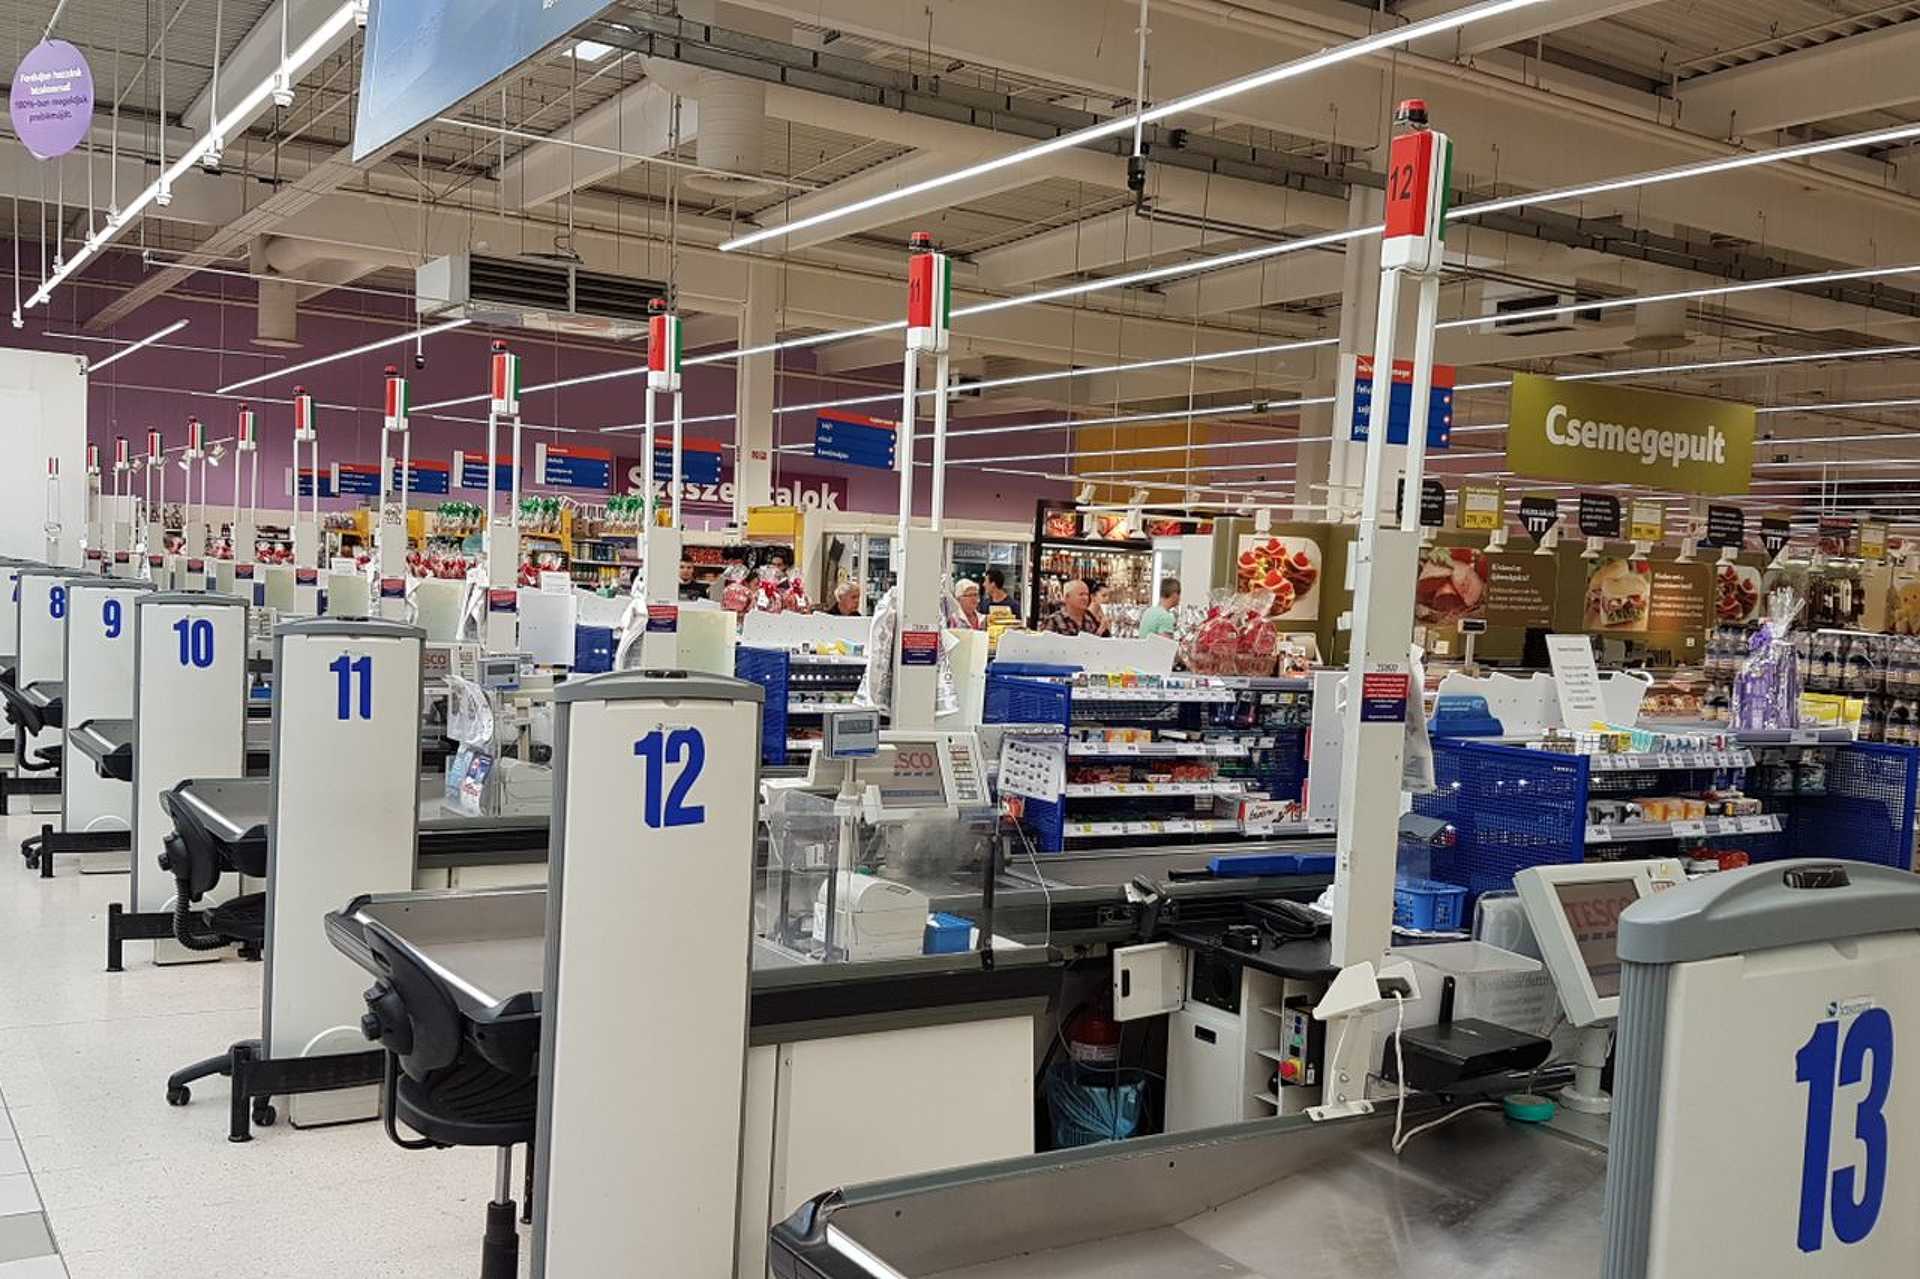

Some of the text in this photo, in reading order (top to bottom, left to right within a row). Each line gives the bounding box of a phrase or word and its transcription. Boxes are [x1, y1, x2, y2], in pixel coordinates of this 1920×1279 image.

[1391, 163, 1413, 201] 12
[910, 278, 921, 303] 11
[1545, 404, 1727, 468] Csemegepult
[1528, 517, 1549, 533] ITT
[50, 586, 65, 618] 8
[103, 600, 121, 638] 9
[173, 619, 214, 668] 10
[330, 656, 371, 721] 11
[634, 727, 705, 828] 12
[1795, 1007, 1894, 1254] 13
